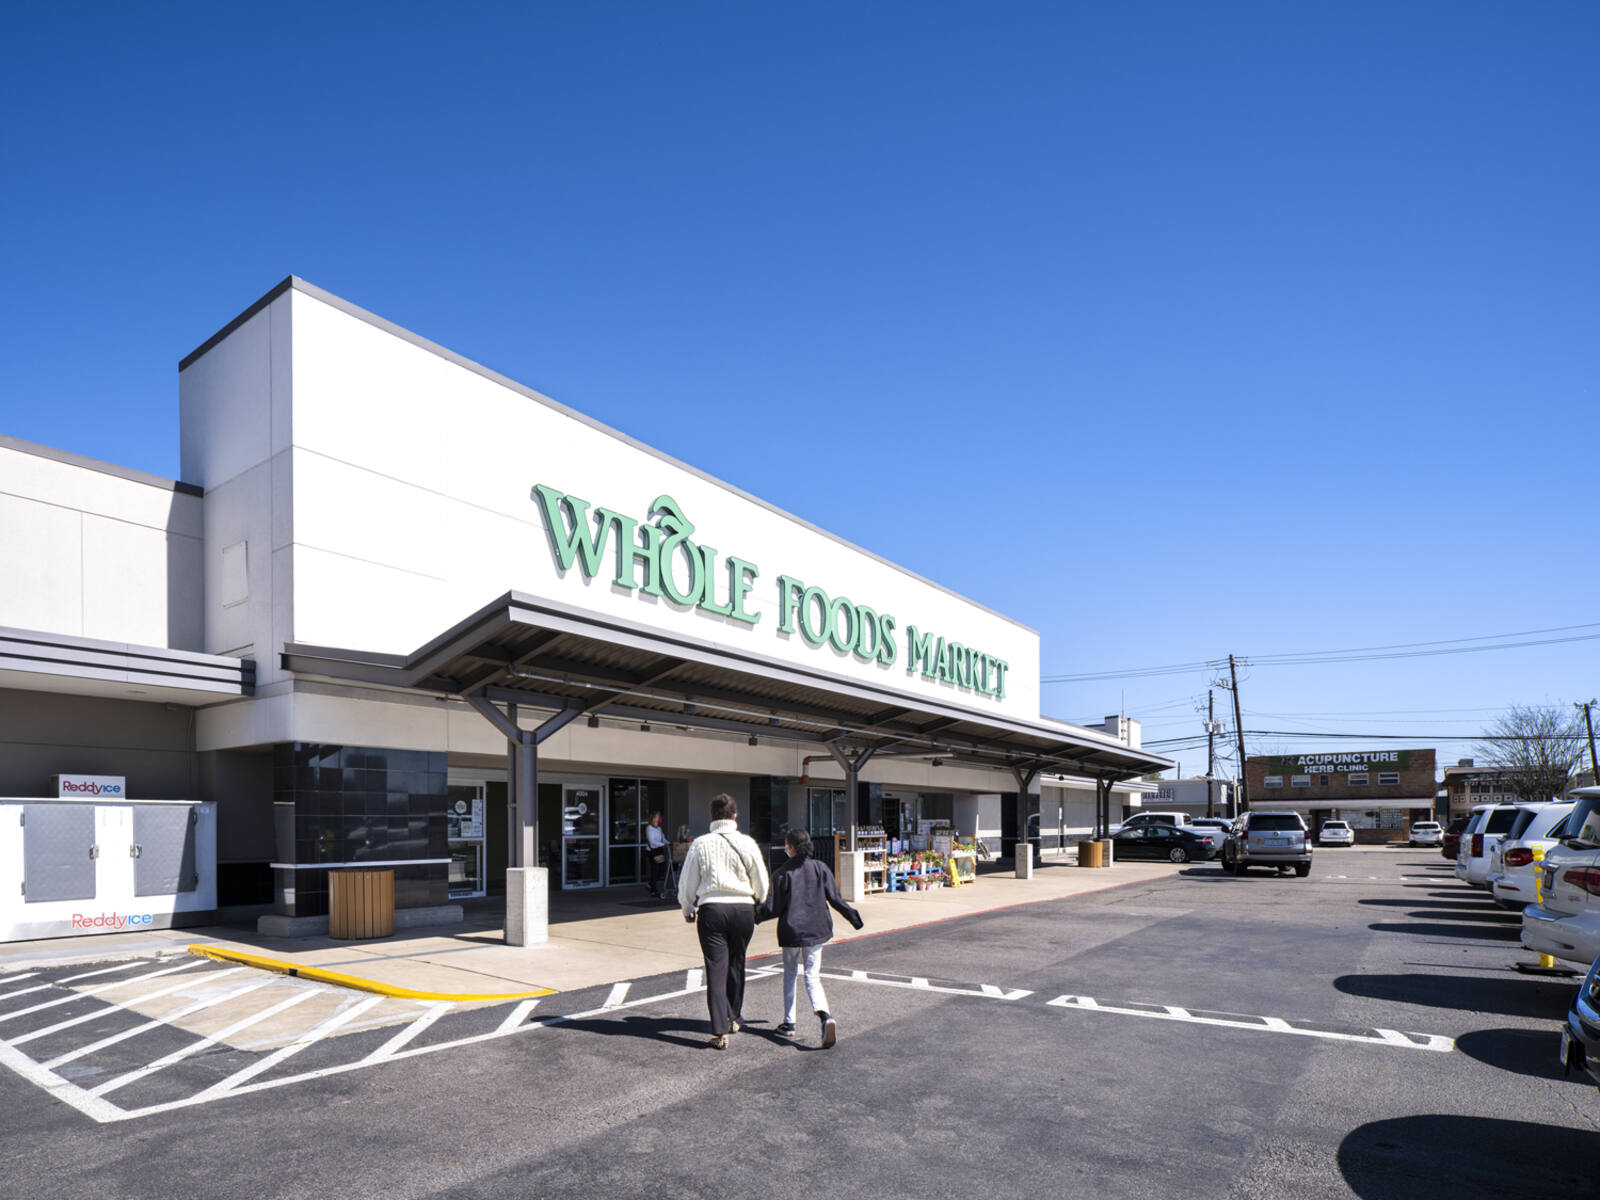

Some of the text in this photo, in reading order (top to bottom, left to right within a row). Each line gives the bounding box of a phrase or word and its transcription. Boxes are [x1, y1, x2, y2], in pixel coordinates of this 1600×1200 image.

[531, 483, 1009, 699] WHOLE FOODS MARKET
[1297, 752, 1398, 766] ACUPUNCTURE
[1304, 764, 1369, 774] HERB CLINIC
